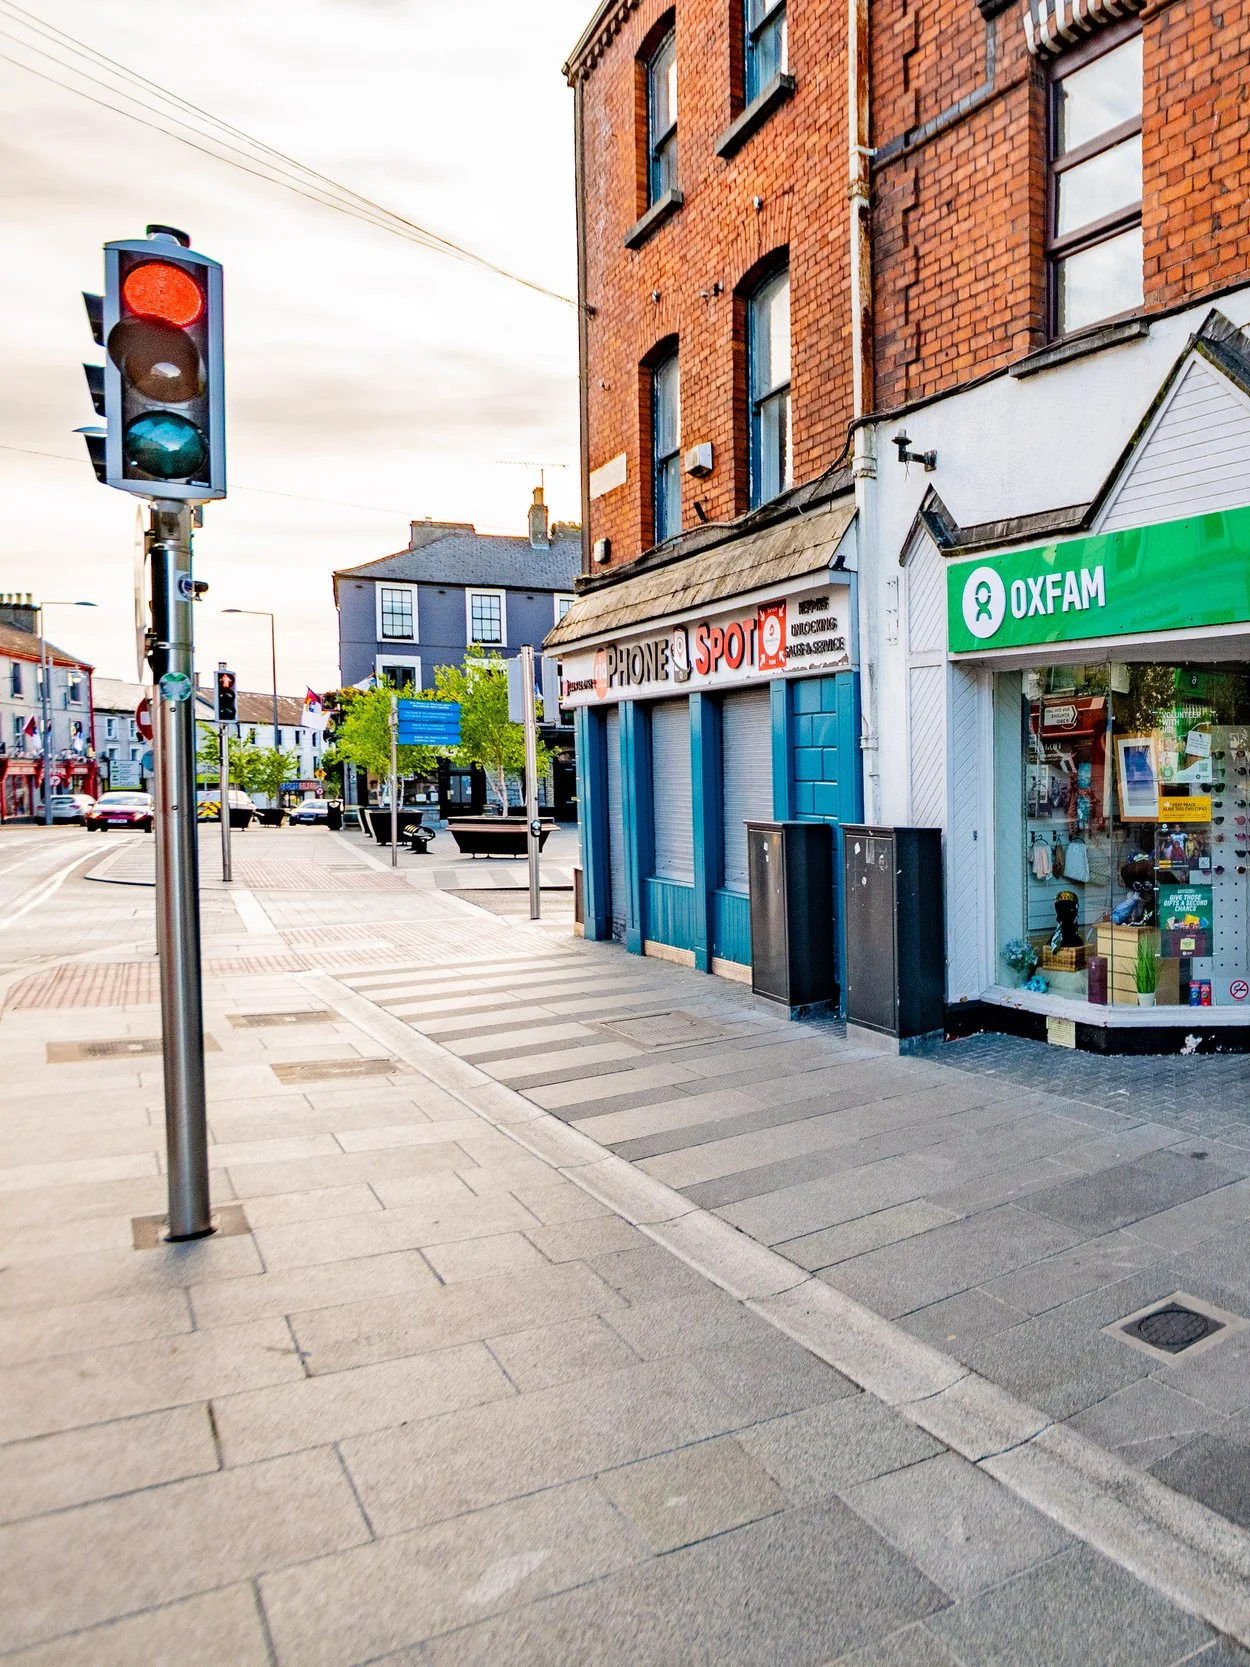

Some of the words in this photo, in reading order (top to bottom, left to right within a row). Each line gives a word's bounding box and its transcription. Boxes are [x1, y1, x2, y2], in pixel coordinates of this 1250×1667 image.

[1010, 565, 1107, 619] OXFAM
[791, 617, 838, 637] UNLOCKING
[606, 639, 669, 688] PHONE
[695, 617, 757, 675] SPOT
[1162, 711, 1202, 719] VOLUNTEER
